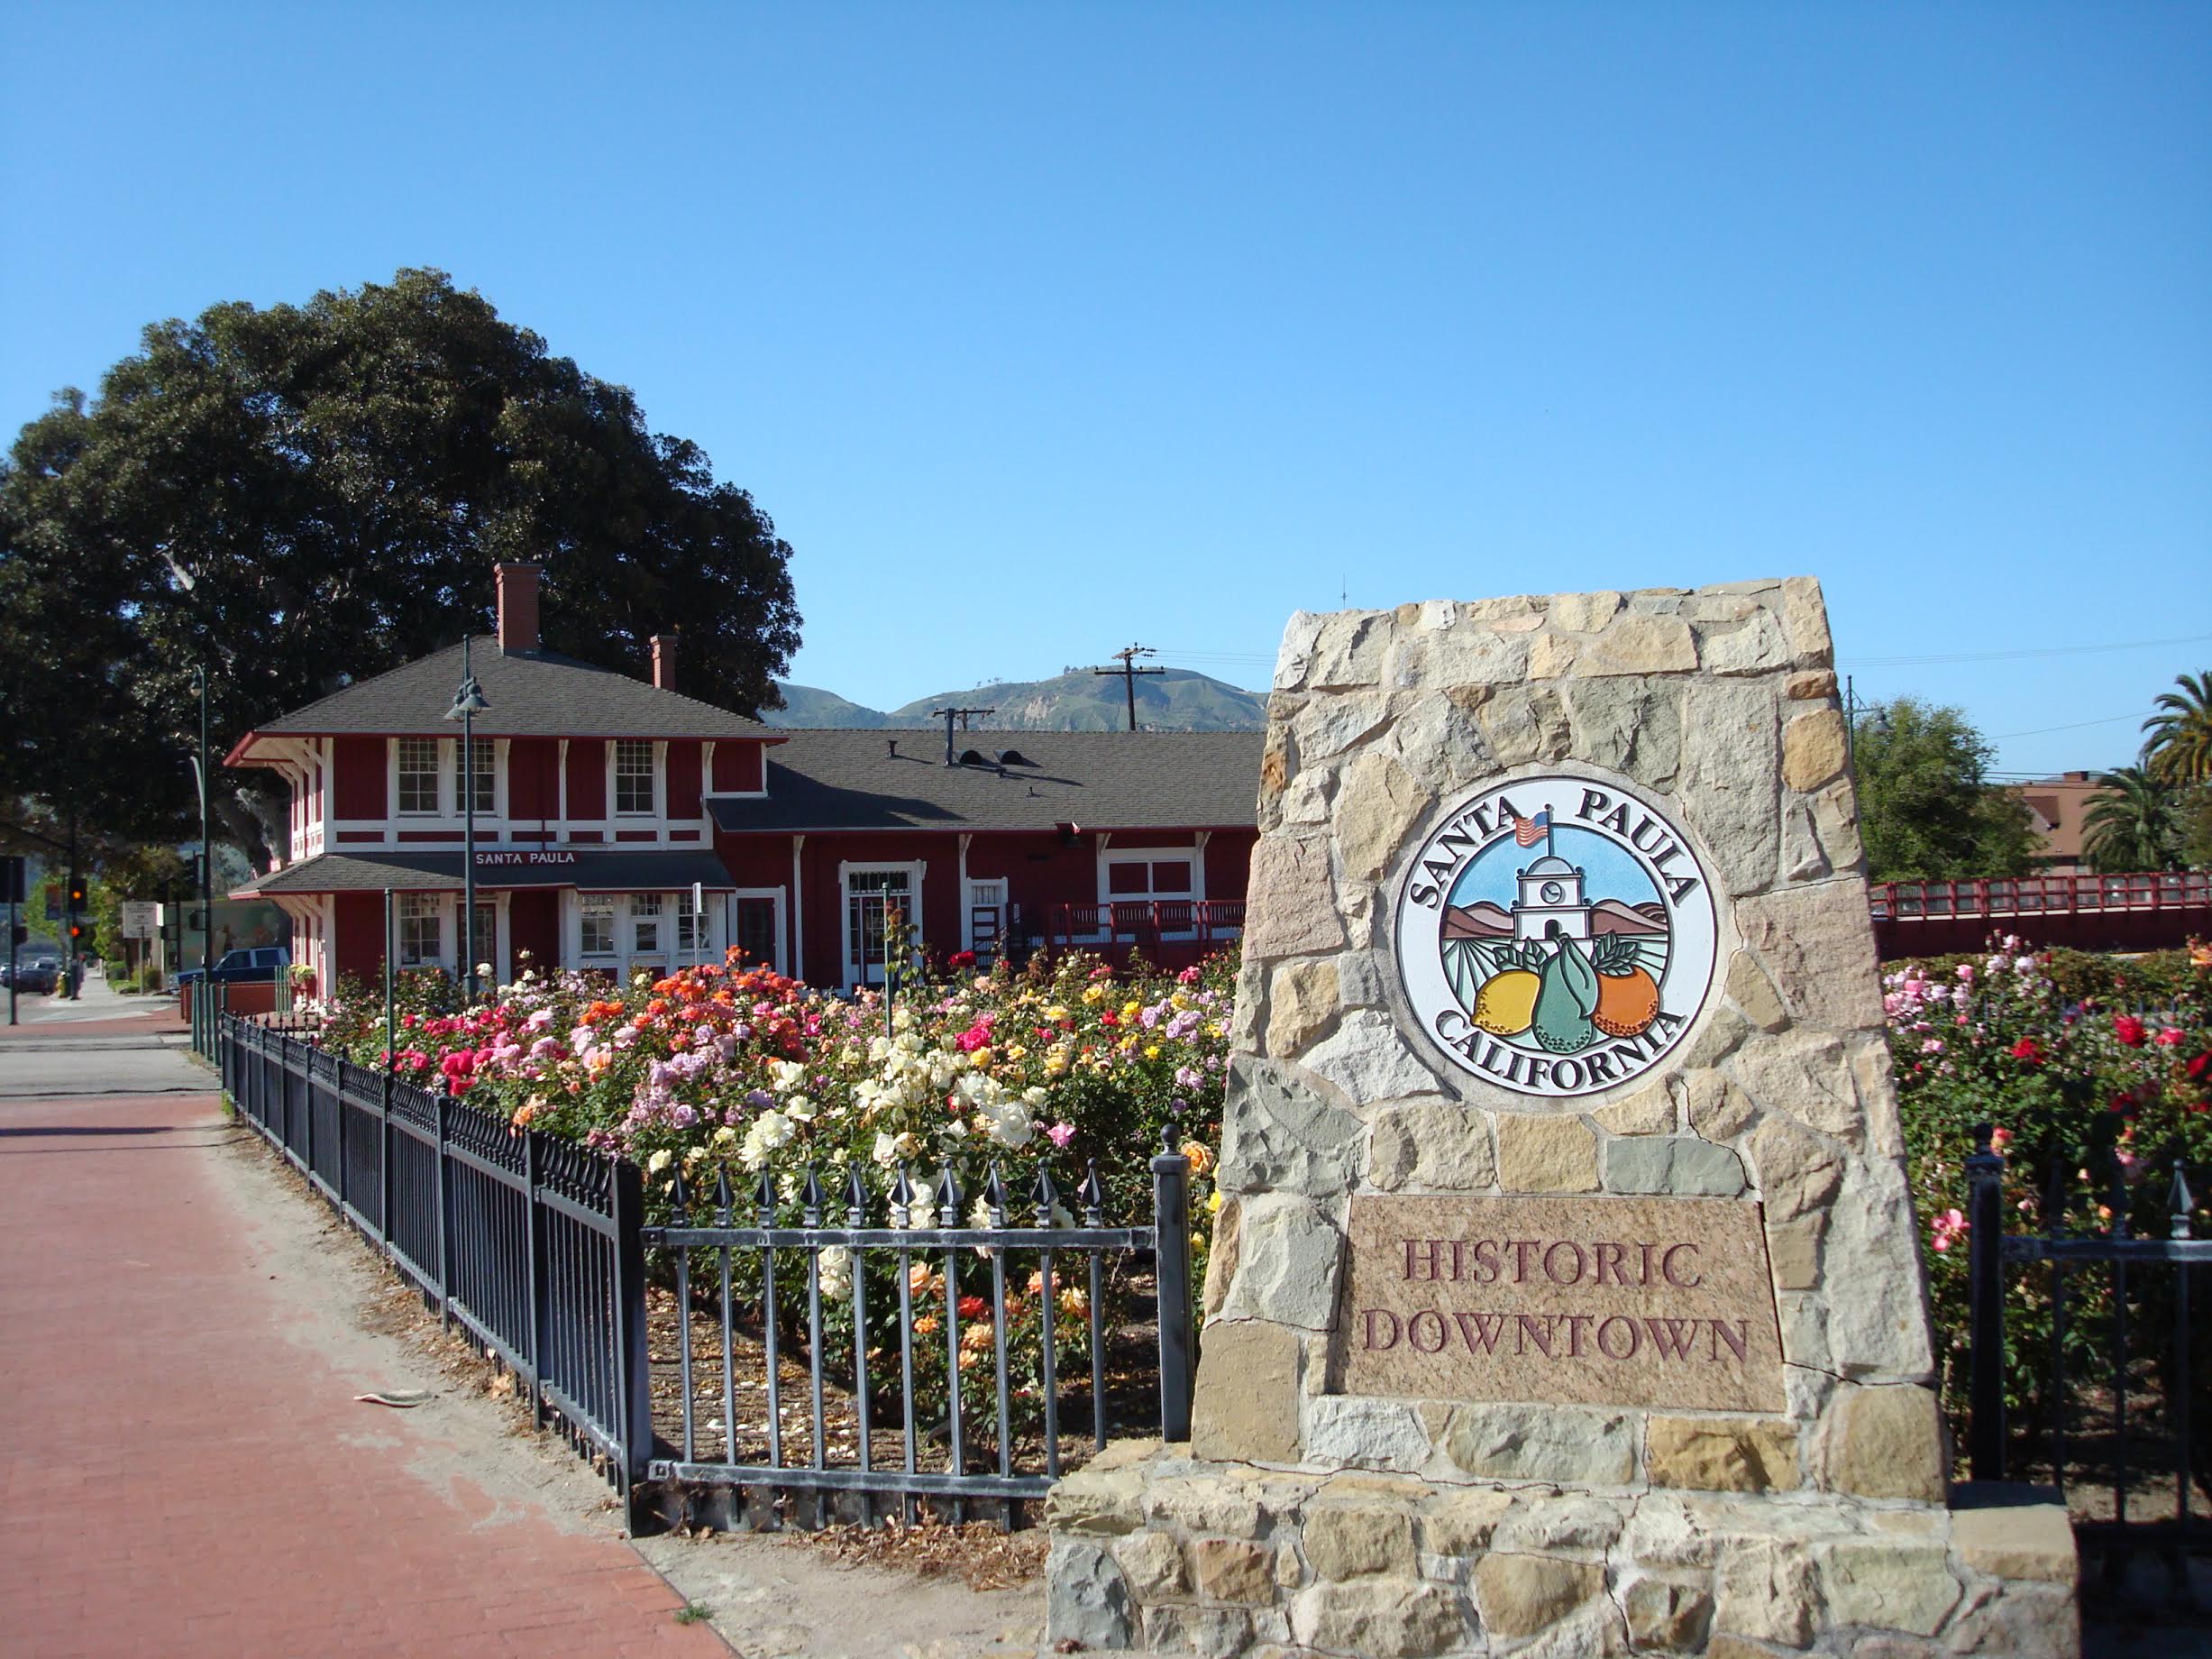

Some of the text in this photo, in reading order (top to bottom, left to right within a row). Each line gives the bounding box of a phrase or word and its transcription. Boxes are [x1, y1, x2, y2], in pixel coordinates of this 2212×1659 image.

[475, 852, 575, 865] SANTA PAULA
[1410, 788, 1701, 911] SANTA PAULA
[1435, 1008, 1688, 1091] CALIFORNIA
[1402, 1238, 1702, 1288] HISTORIC
[1361, 1308, 1751, 1364] DOWNTOWN
